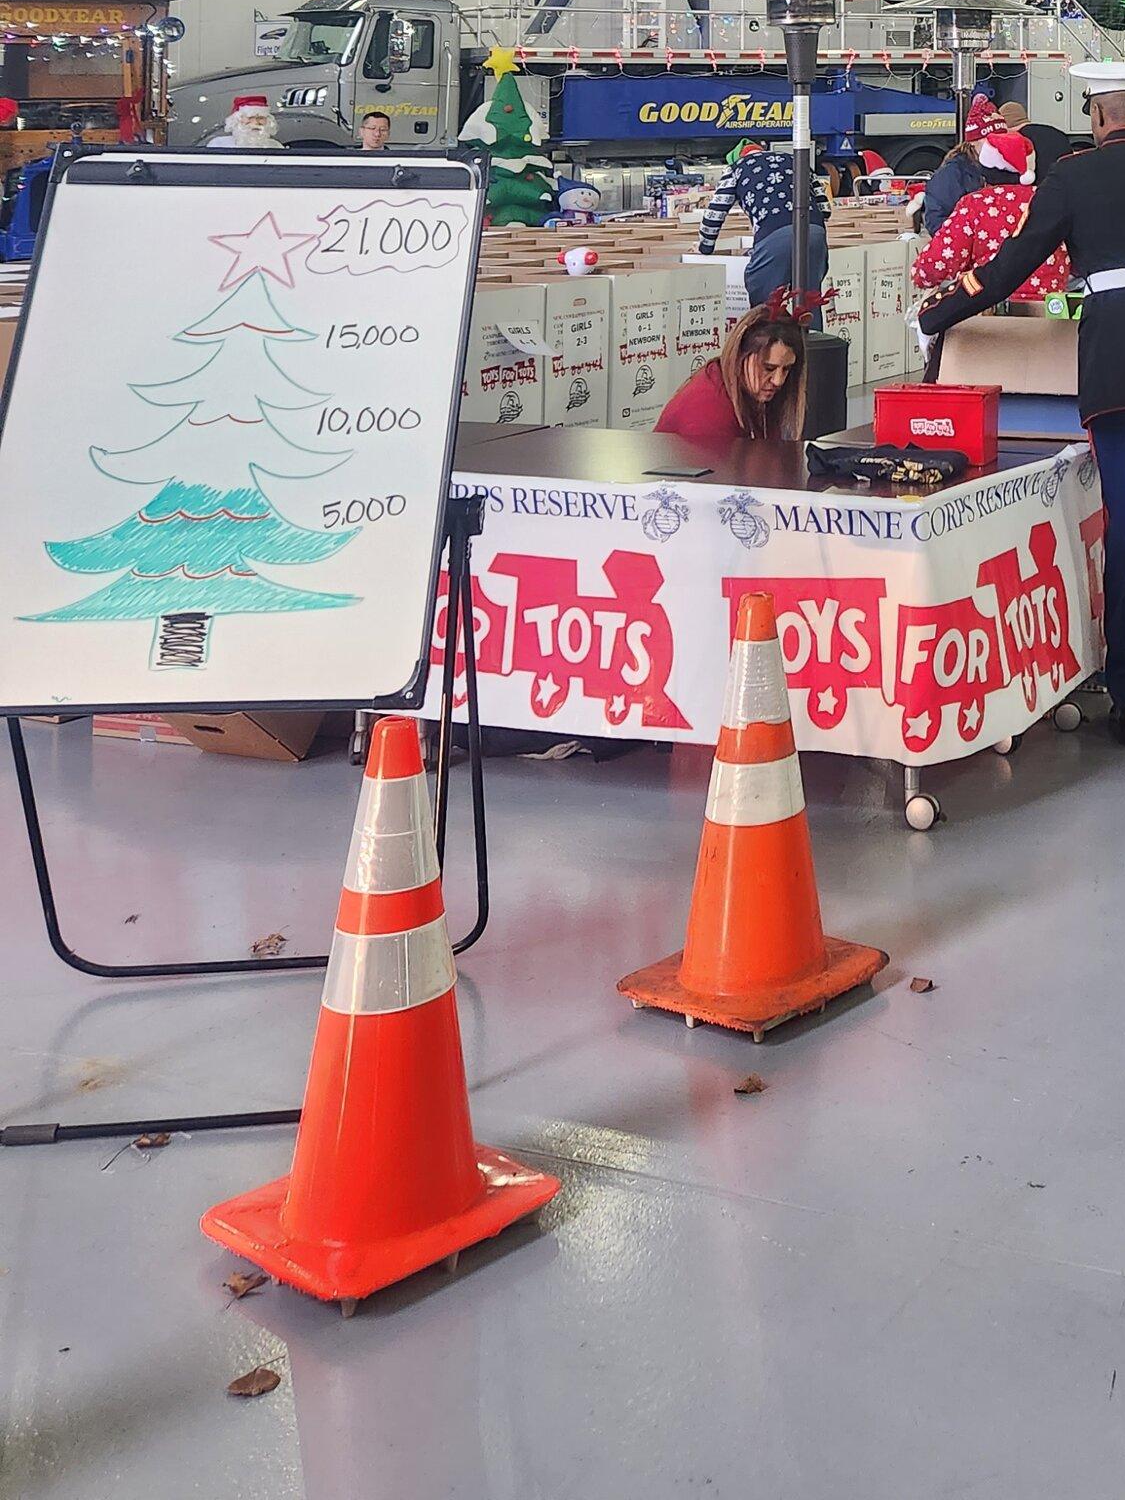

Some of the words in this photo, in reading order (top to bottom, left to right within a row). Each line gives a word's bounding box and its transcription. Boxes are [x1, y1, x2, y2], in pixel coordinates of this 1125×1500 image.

[724, 120, 755, 129] AIRSHIP
[756, 120, 794, 128] OPERATIO
[980, 125, 994, 136] OH
[880, 279, 894, 288] BOYS
[688, 304, 706, 313] BOYS
[635, 311, 654, 320] GIRLS
[507, 326, 532, 335] GIRLS
[571, 320, 593, 333] GIRLS
[326, 324, 419, 349] 15,000
[682, 328, 711, 338] NEWBORN
[628, 335, 661, 346] NEWBORN
[317, 407, 421, 435] 10,000
[511, 487, 640, 521] RESERVE
[772, 503, 903, 540] MARINE
[911, 494, 975, 542] CORPS
[975, 471, 1046, 519] RESERVE
[322, 494, 406, 529] 5,000
[775, 597, 872, 674] OYS
[901, 623, 991, 688] FOR
[1004, 586, 1062, 654] TOTS
[523, 603, 652, 686] TOTS
